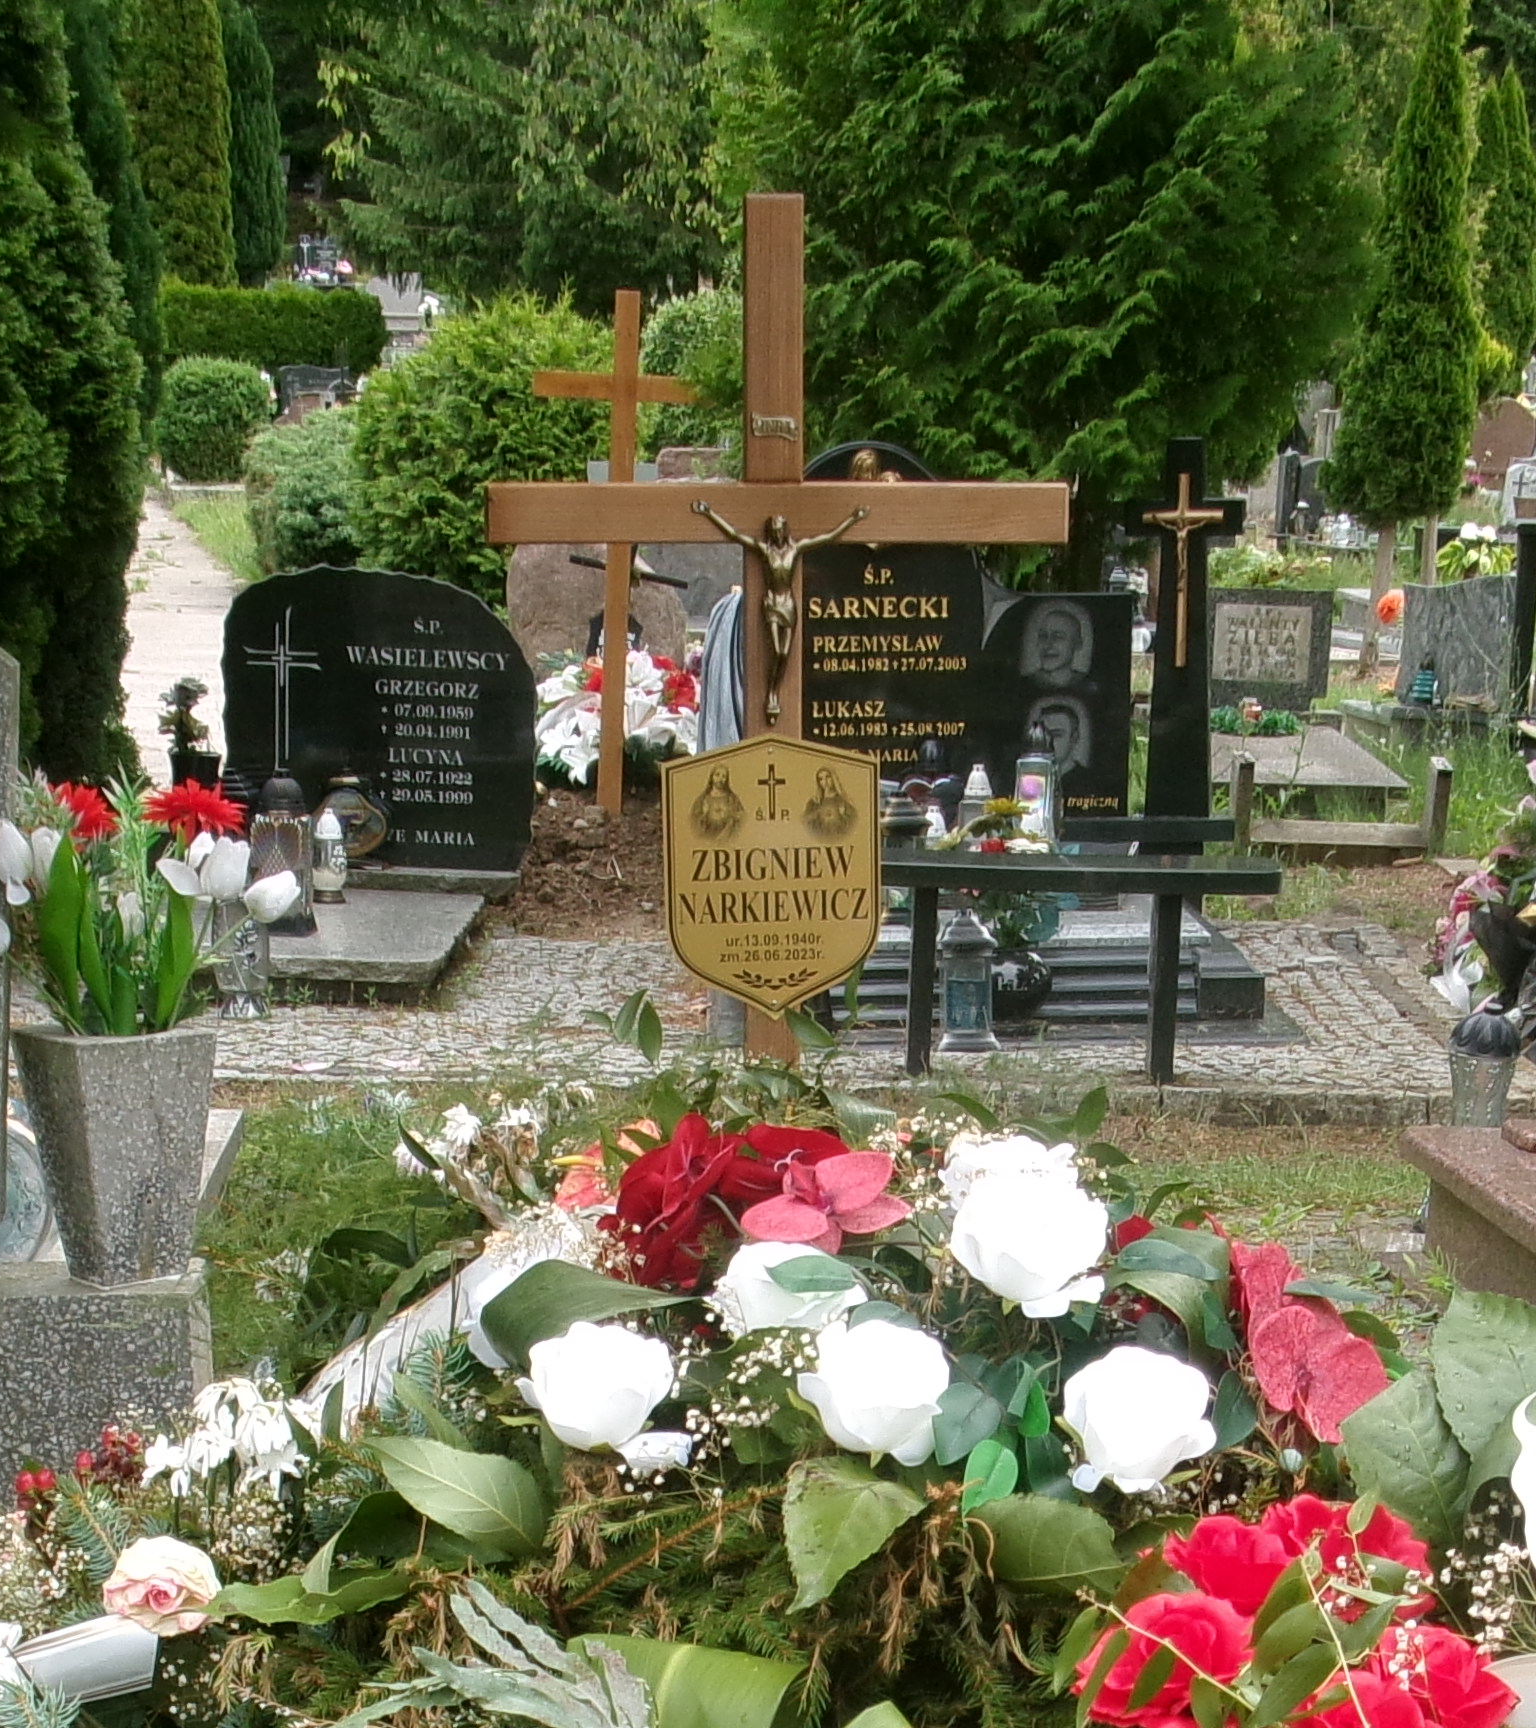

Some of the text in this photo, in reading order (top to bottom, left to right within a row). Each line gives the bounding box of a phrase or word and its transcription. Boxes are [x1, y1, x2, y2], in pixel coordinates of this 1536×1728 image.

[864, 562, 894, 585] Ś.P.
[808, 596, 949, 619] SARNECKI
[346, 645, 510, 671] WASIELEWSCY
[375, 678, 480, 700] GRZEGORZ
[394, 703, 474, 720] 07.09.1959
[394, 723, 471, 740] 20.04.1991
[388, 748, 464, 766] LUCYNA
[415, 829, 476, 846] MARIA
[692, 845, 855, 882] ZBIGNIEW
[678, 888, 869, 926] NARKIEWICZ
